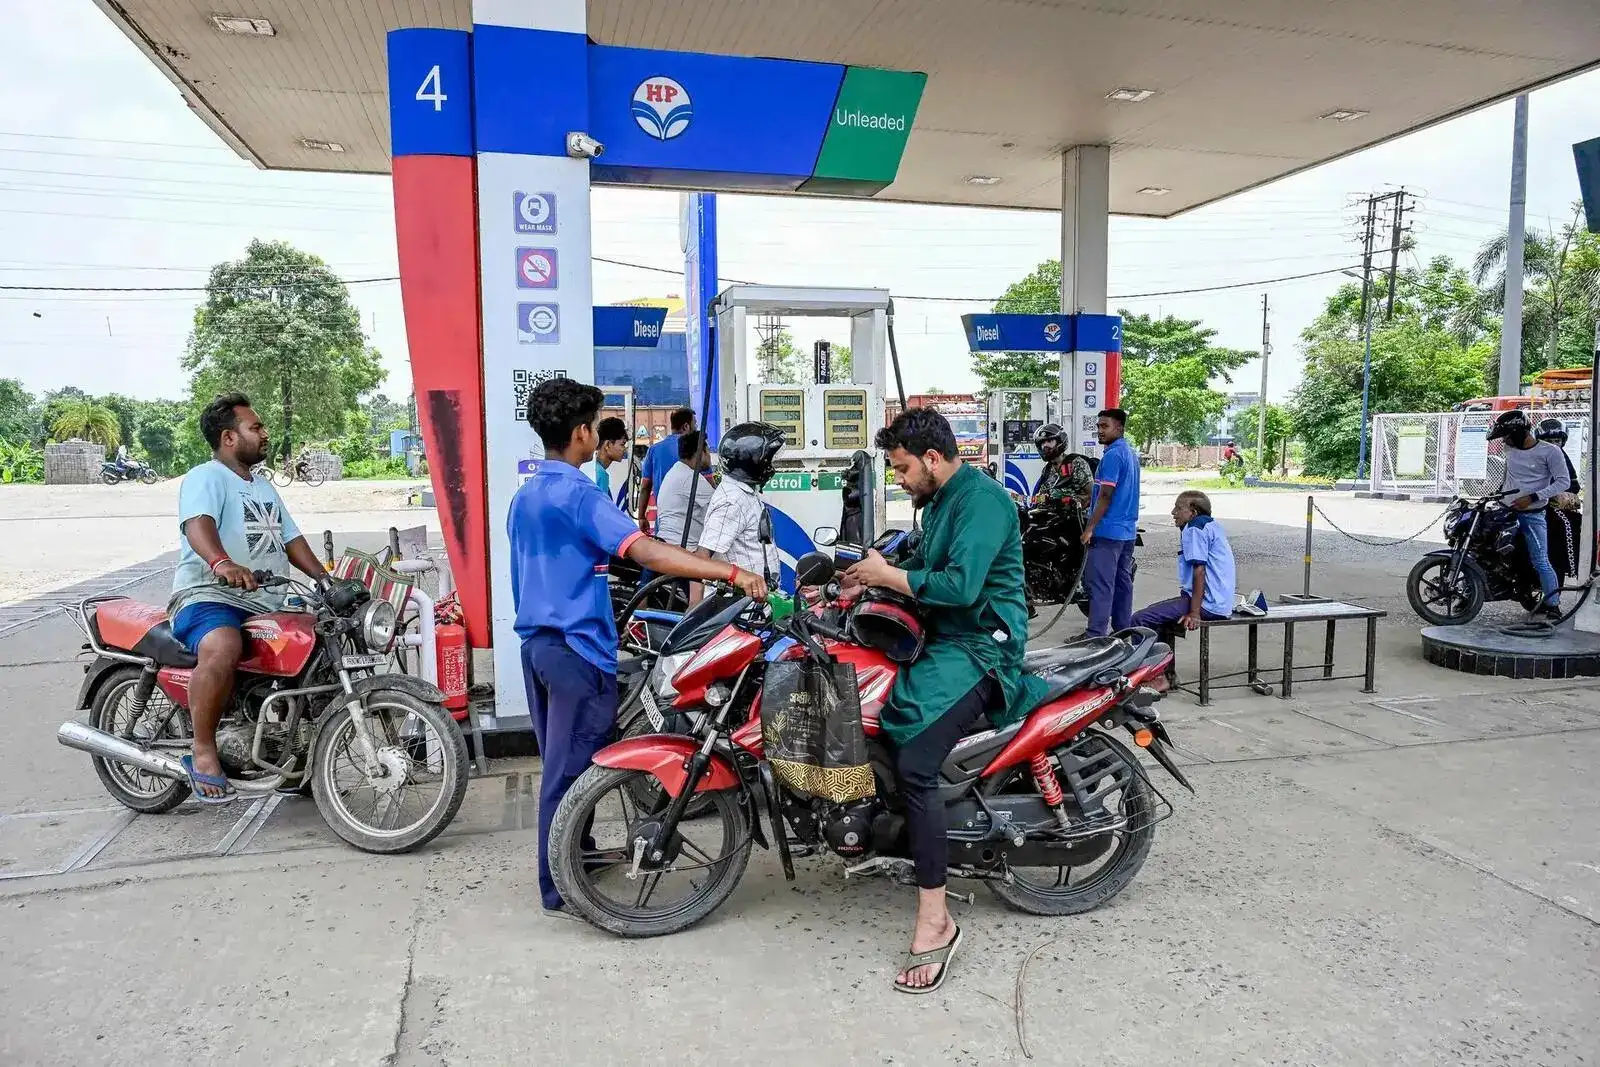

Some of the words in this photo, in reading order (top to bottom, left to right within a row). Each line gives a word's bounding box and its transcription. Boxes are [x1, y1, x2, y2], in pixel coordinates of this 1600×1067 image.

[415, 64, 448, 111] 4
[646, 83, 678, 103] HP
[836, 108, 905, 131] Unleaded
[519, 223, 536, 231] WEAR
[633, 319, 660, 338] Diesel
[976, 323, 999, 342] Diesel
[1111, 325, 1119, 340] 2
[766, 475, 802, 489] etrol
